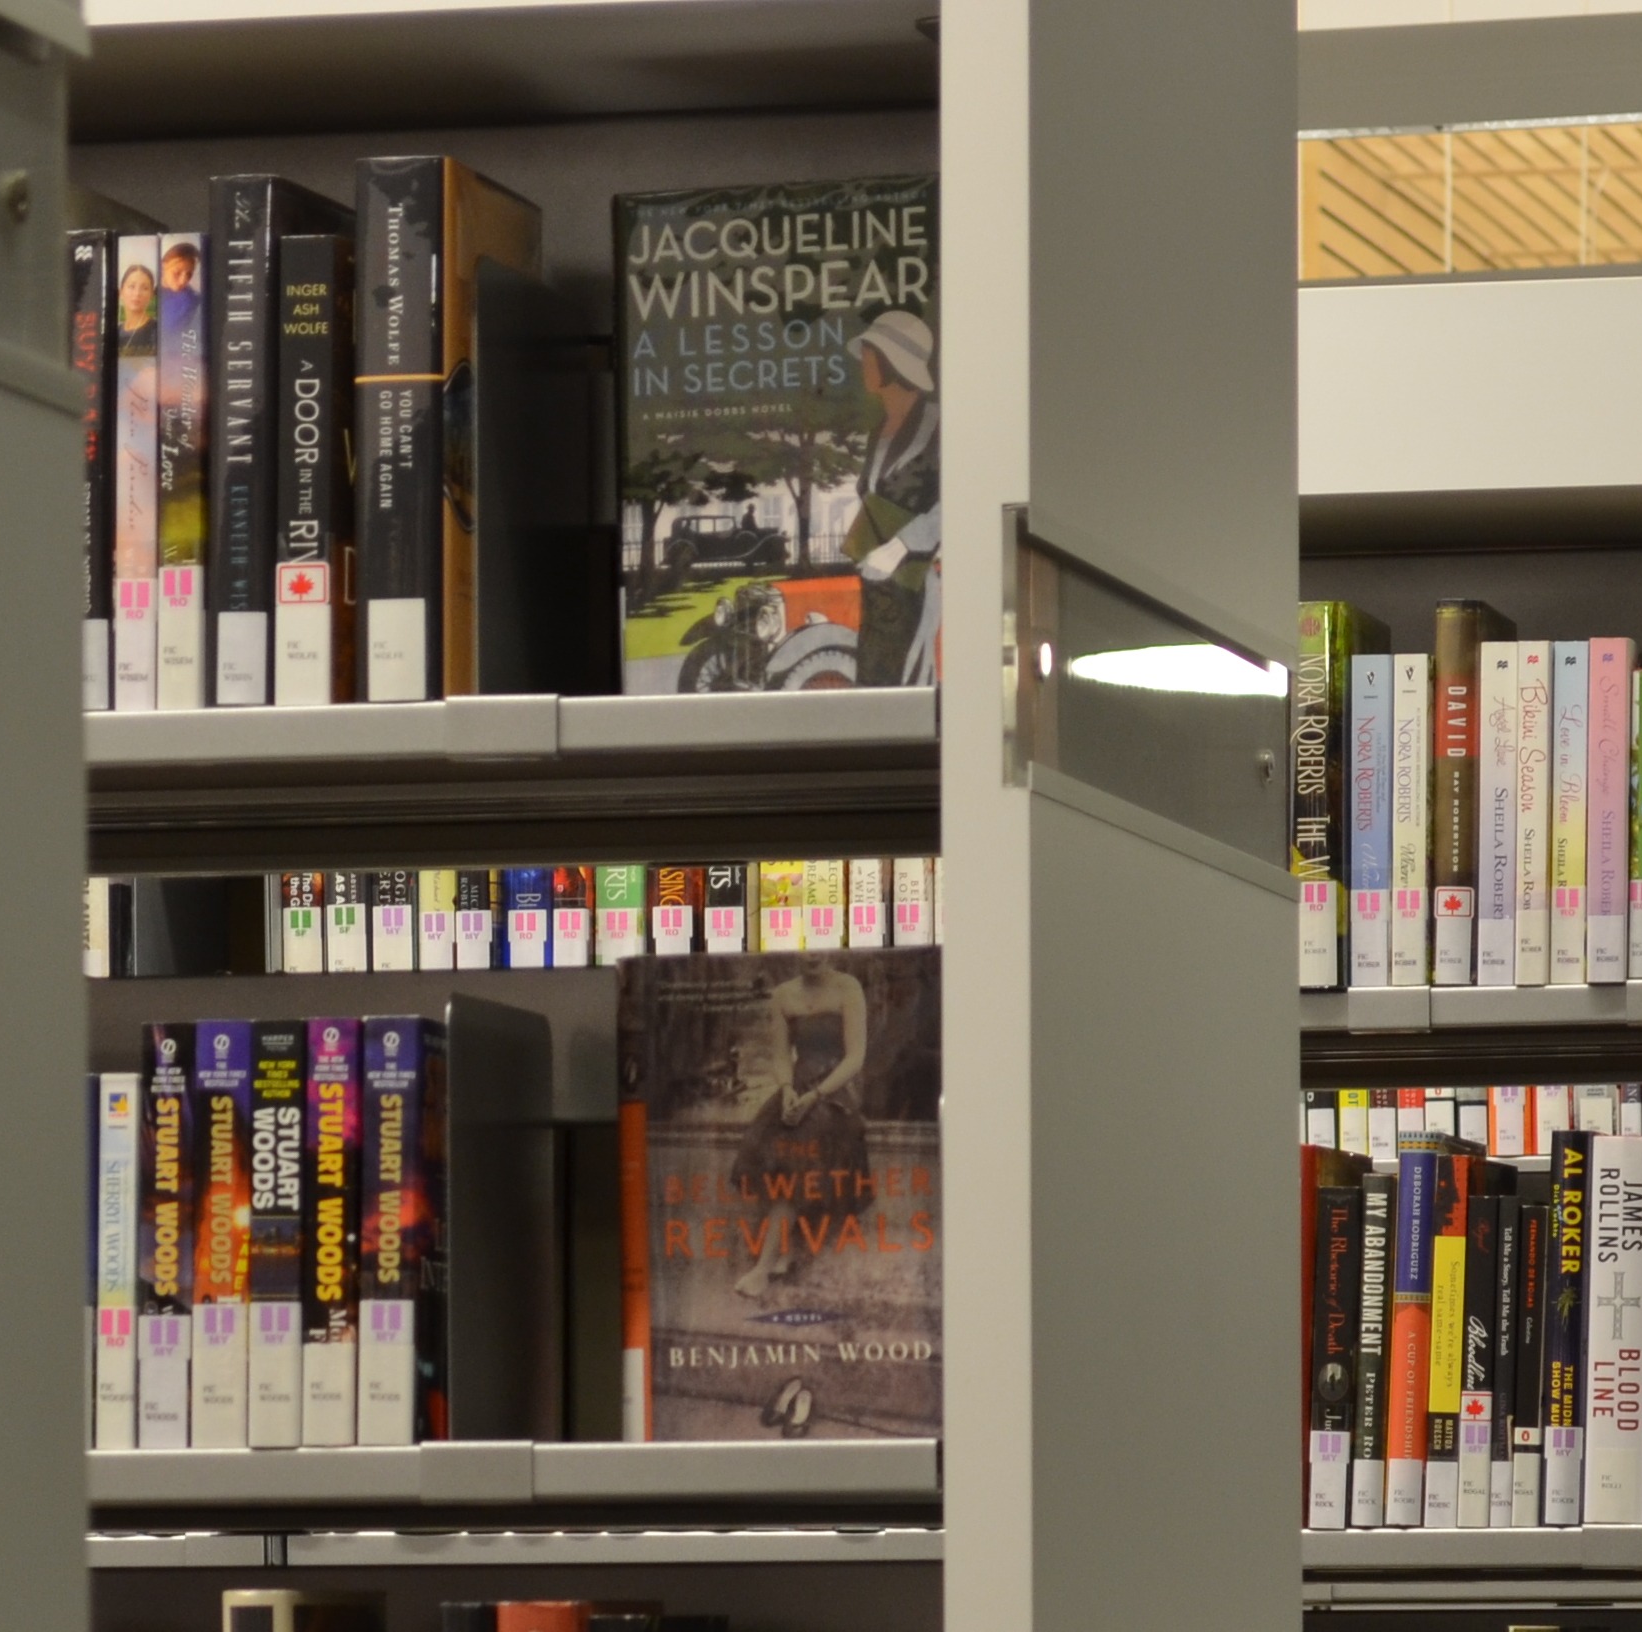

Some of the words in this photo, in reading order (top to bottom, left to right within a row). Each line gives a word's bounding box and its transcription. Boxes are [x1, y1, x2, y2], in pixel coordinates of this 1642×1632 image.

[388, 203, 403, 287] THOMAS
[628, 206, 928, 265] JACQUELINE
[228, 240, 254, 322] FIFTH
[286, 284, 327, 297] INGER
[629, 256, 928, 322] WINSPEAR
[283, 322, 329, 335] WOLFE
[293, 304, 320, 316] ASH
[388, 295, 403, 366] WOLFE
[634, 331, 656, 359] A
[679, 318, 844, 356] LESSON
[301, 360, 314, 373] A
[633, 367, 668, 396] IN
[684, 355, 846, 393] SECRETS
[227, 340, 254, 464] SERVANT
[295, 378, 320, 464] DOOR
[379, 390, 393, 410] GO
[399, 390, 412, 418] YOU
[704, 406, 745, 417] DOBBS
[752, 404, 793, 415] NOVEL
[379, 417, 393, 457] HOME
[399, 425, 412, 468] CAN'T
[298, 487, 312, 515] THE
[299, 469, 312, 484] IN
[379, 463, 393, 509] AGAIN
[125, 610, 144, 620] RO
[1297, 653, 1326, 708] NORA
[1599, 675, 1617, 736] Small
[1447, 686, 1467, 757] DAVID
[1520, 678, 1548, 740] Bikini
[1560, 703, 1583, 751] Love
[1290, 715, 1329, 795] ROBERTS
[1356, 716, 1376, 763] NORA
[1397, 719, 1414, 762] NORA
[1355, 767, 1375, 832] ROBERTS
[1396, 765, 1412, 824] ROBERTS
[1519, 746, 1547, 813] Season
[1296, 815, 1331, 847] THE
[1493, 786, 1508, 849] SHEILA
[1601, 809, 1616, 863] SHEILA
[1523, 828, 1535, 876] SHEILA
[1557, 836, 1567, 875] SHEILA
[519, 932, 533, 940] RO
[155, 1097, 179, 1193] STUART
[211, 1096, 233, 1185] STUART
[252, 1106, 275, 1210] WOODS
[277, 1106, 301, 1210] STUART
[317, 1083, 344, 1188] STUART
[379, 1094, 402, 1184] STUART
[1563, 1148, 1584, 1178] AL
[664, 1166, 933, 1206] BELLWETHER
[1366, 1193, 1386, 1218] MY
[1411, 1166, 1422, 1213] DEBORAH
[210, 1193, 232, 1285] WOODS
[378, 1191, 401, 1284] WOODS
[664, 1212, 935, 1258] REVIVALS
[1561, 1189, 1583, 1275] ROKER
[1597, 1167, 1620, 1263] ROLLINS
[153, 1202, 179, 1297] WOODS
[316, 1197, 342, 1302] WOODS
[1409, 1214, 1420, 1280] RODRIGUEZ
[1361, 1223, 1386, 1356] ABANDONMENT
[669, 1343, 821, 1369] BENJAMIN
[837, 1341, 933, 1362] WOOD
[1563, 1365, 1574, 1390] THE
[1365, 1371, 1377, 1425] PETER
[1593, 1361, 1615, 1418] LINE
[1617, 1347, 1641, 1432] BLOOD
